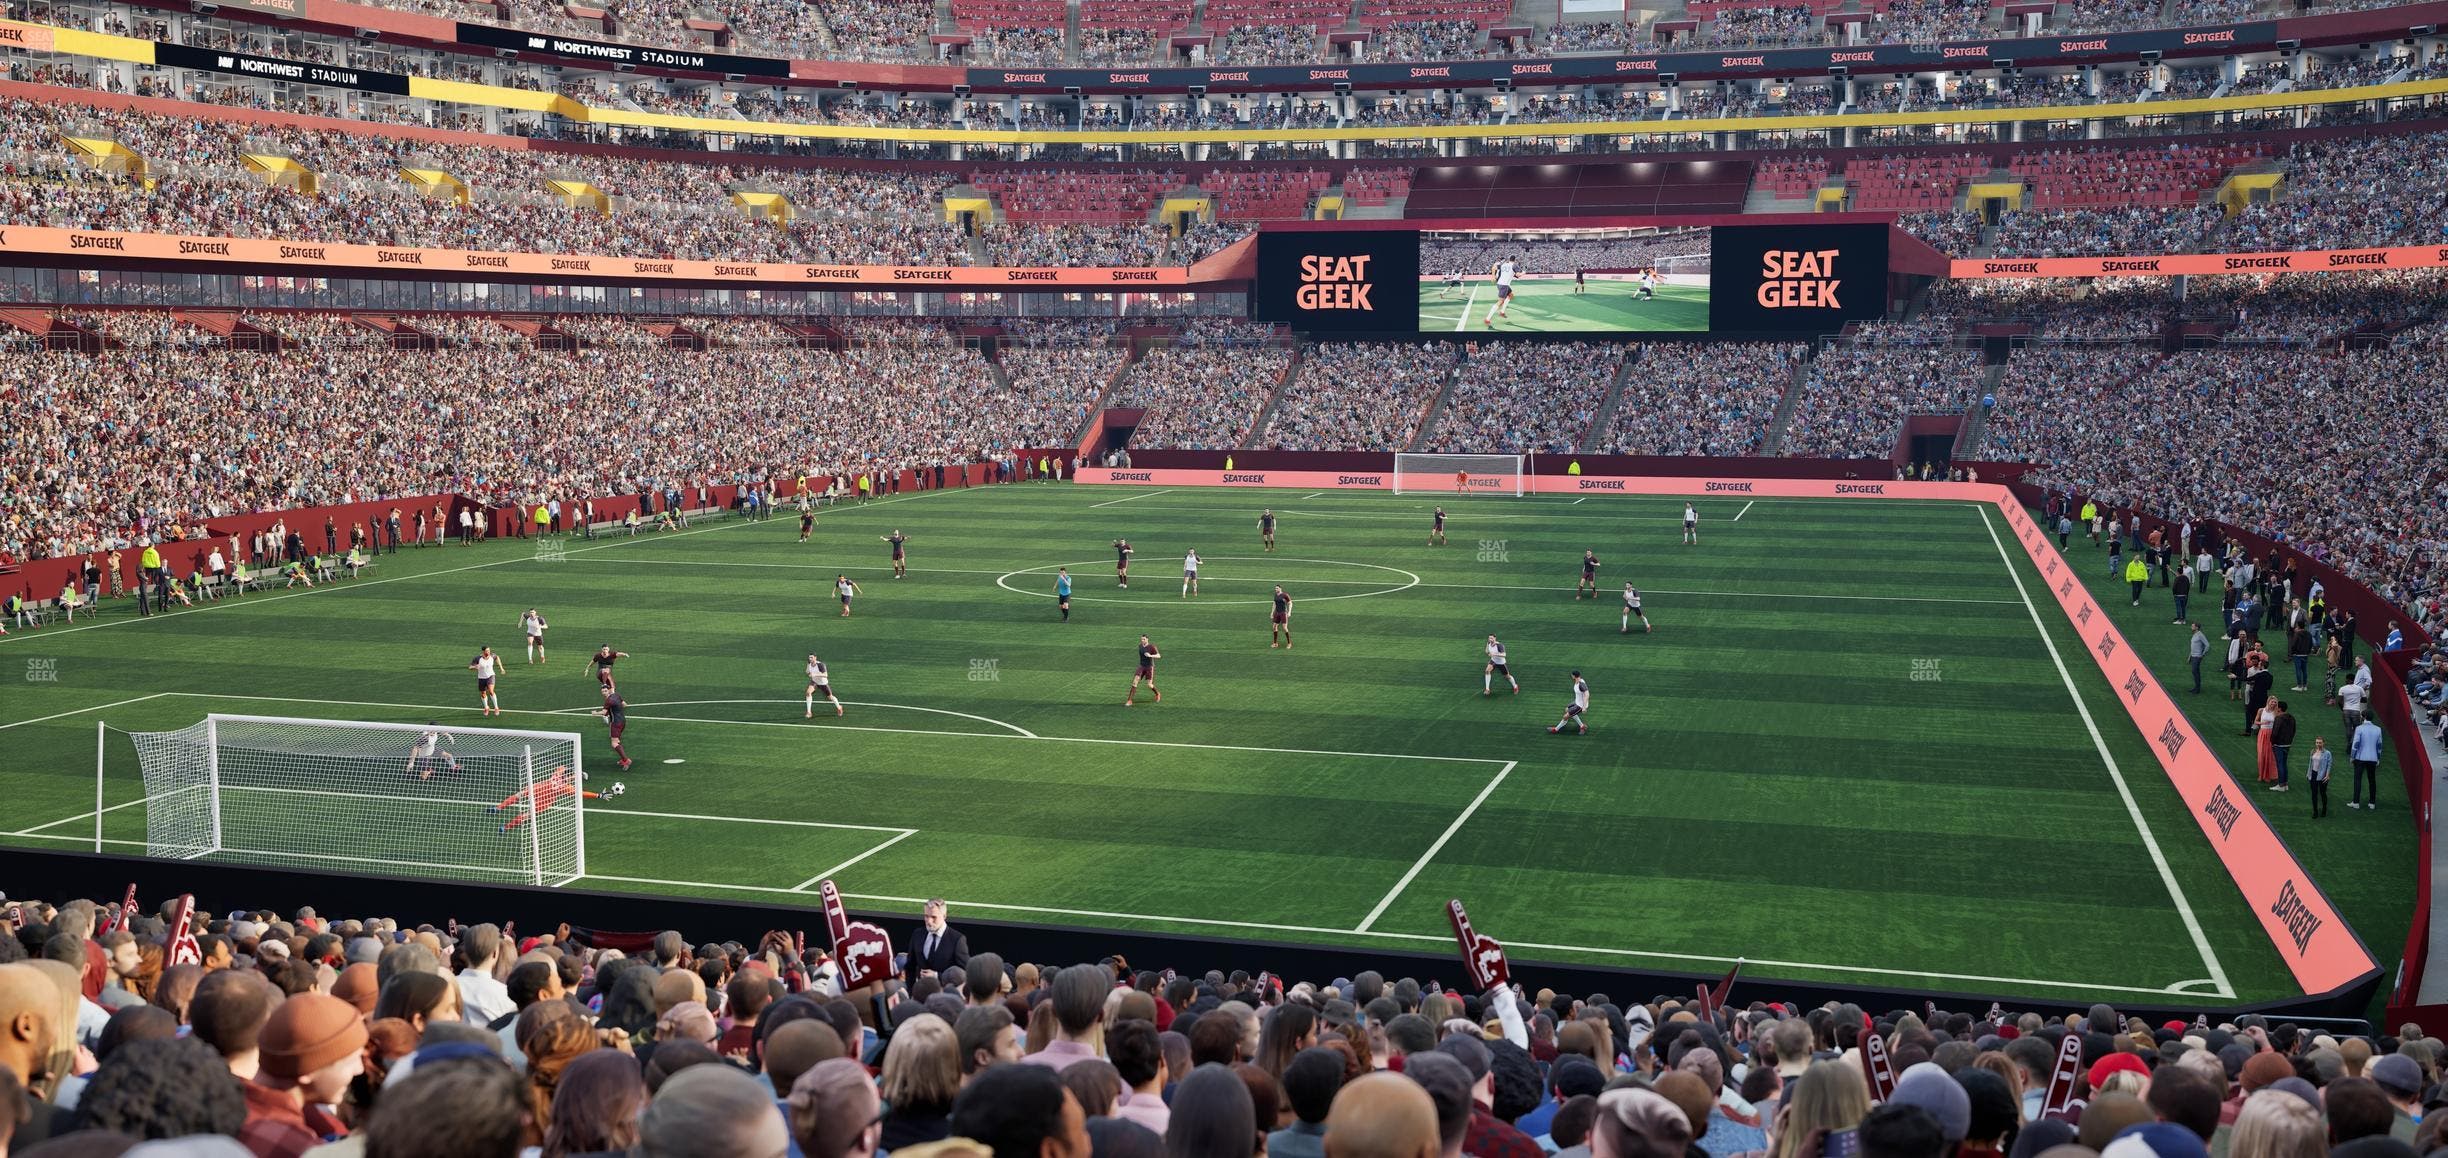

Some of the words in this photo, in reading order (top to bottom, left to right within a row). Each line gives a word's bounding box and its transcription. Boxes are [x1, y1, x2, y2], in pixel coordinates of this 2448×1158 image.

[2183, 29, 2235, 45] SEATGEEK
[1943, 45, 1989, 58] SEATGEEK
[2060, 39, 2108, 53] SEATGEEK
[553, 40, 633, 60] NORTHWEST
[641, 50, 704, 67] STADIUM
[1830, 50, 1874, 63] SEATGEEK
[1615, 59, 1657, 71] SEATGEEK
[1722, 55, 1764, 68] SEATGEEK
[240, 58, 304, 78] NORTHWEST
[311, 68, 358, 85] STADIUM
[1309, 69, 1349, 80] SEATGEEK
[1410, 66, 1450, 78] SEATGEEK
[1512, 63, 1553, 75] SEATGEEK
[1003, 72, 1046, 83] SEATGEEK
[1109, 73, 1150, 84] SEATGEEK
[1209, 71, 1249, 82] SEATGEEK
[70, 234, 125, 251] SEATGEEK
[179, 240, 230, 256] SEATGEEK
[280, 245, 326, 261] SEATGEEK
[377, 250, 423, 265] SEATGEEK
[2328, 251, 2388, 267] SEATGEEK
[466, 254, 509, 268] SEATGEEK
[551, 258, 591, 271] SEATGEEK
[1762, 249, 1840, 279] SEAT
[2101, 259, 2160, 273] SEATGEEK
[2225, 256, 2291, 270] SEATGEEK
[634, 262, 674, 275] SEATGEEK
[714, 265, 758, 277] SEATGEEK
[806, 267, 860, 279] SEATGEEK
[1300, 254, 1371, 283] SEAT
[1984, 262, 2039, 274] SEATGEEK
[893, 269, 953, 281] SEATGEEK
[1008, 270, 1058, 281] SEATGEEK
[1112, 270, 1158, 281] SEATGEEK
[1296, 283, 1374, 311] GEEK
[1757, 279, 1842, 309] GEEK
[1110, 471, 1152, 482] SEATGEEK
[1222, 473, 1265, 484] SEATGEEK
[1337, 475, 1382, 486] SEATGEEK
[1467, 478, 1502, 488] ATGEEK
[1579, 479, 1625, 490] SEATGEEK
[1705, 481, 1753, 493] SEATGEEK
[1835, 483, 1884, 495] SEATGEEK
[2204, 783, 2242, 842] SEATGEEK
[2270, 878, 2323, 959] SEATGEEK
